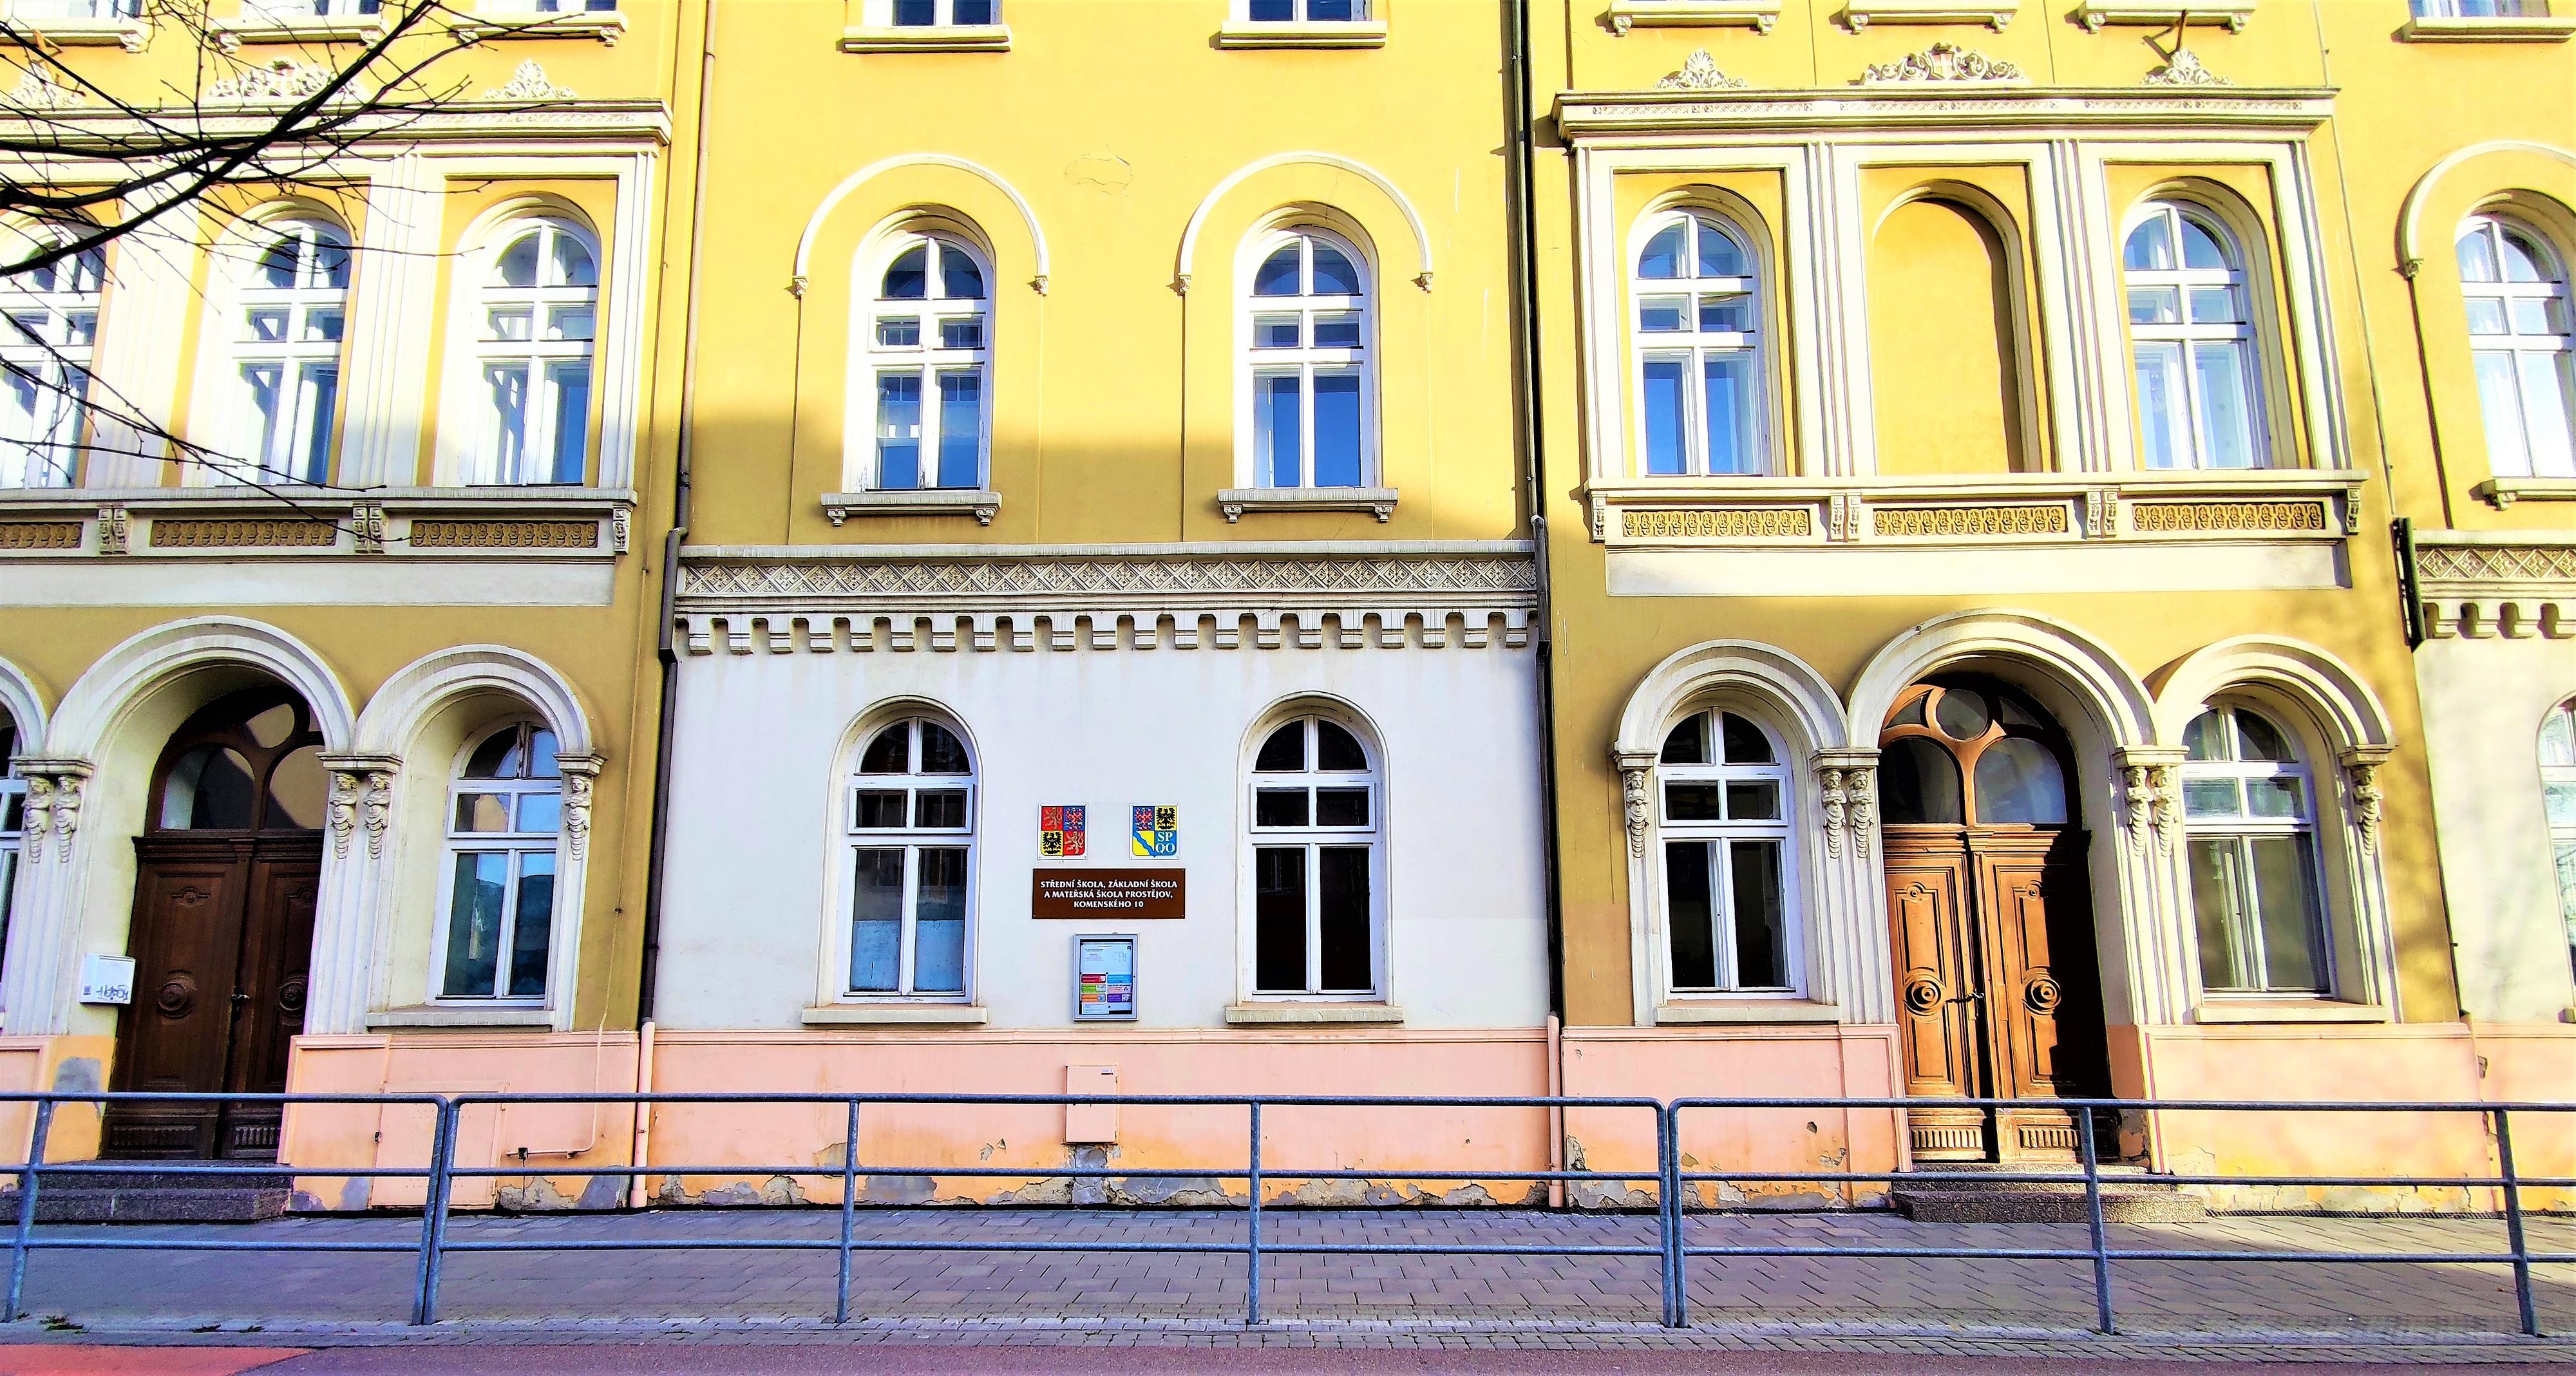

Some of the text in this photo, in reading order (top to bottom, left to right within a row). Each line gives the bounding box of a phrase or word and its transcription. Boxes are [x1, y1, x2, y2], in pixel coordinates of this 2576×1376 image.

[1157, 831, 1173, 842] SP
[1155, 843, 1175, 854] QO
[1040, 880, 1178, 889] STŘEDNÍ ŠKOLA, ZÁKLADNÍ ŠKOLA
[1052, 889, 1094, 898] MATEŘSKÁ
[1096, 889, 1123, 898] ŠKOLA
[1125, 889, 1173, 900] PROSTĚJOV,
[1074, 900, 1132, 908] KOMENSKÉHO
